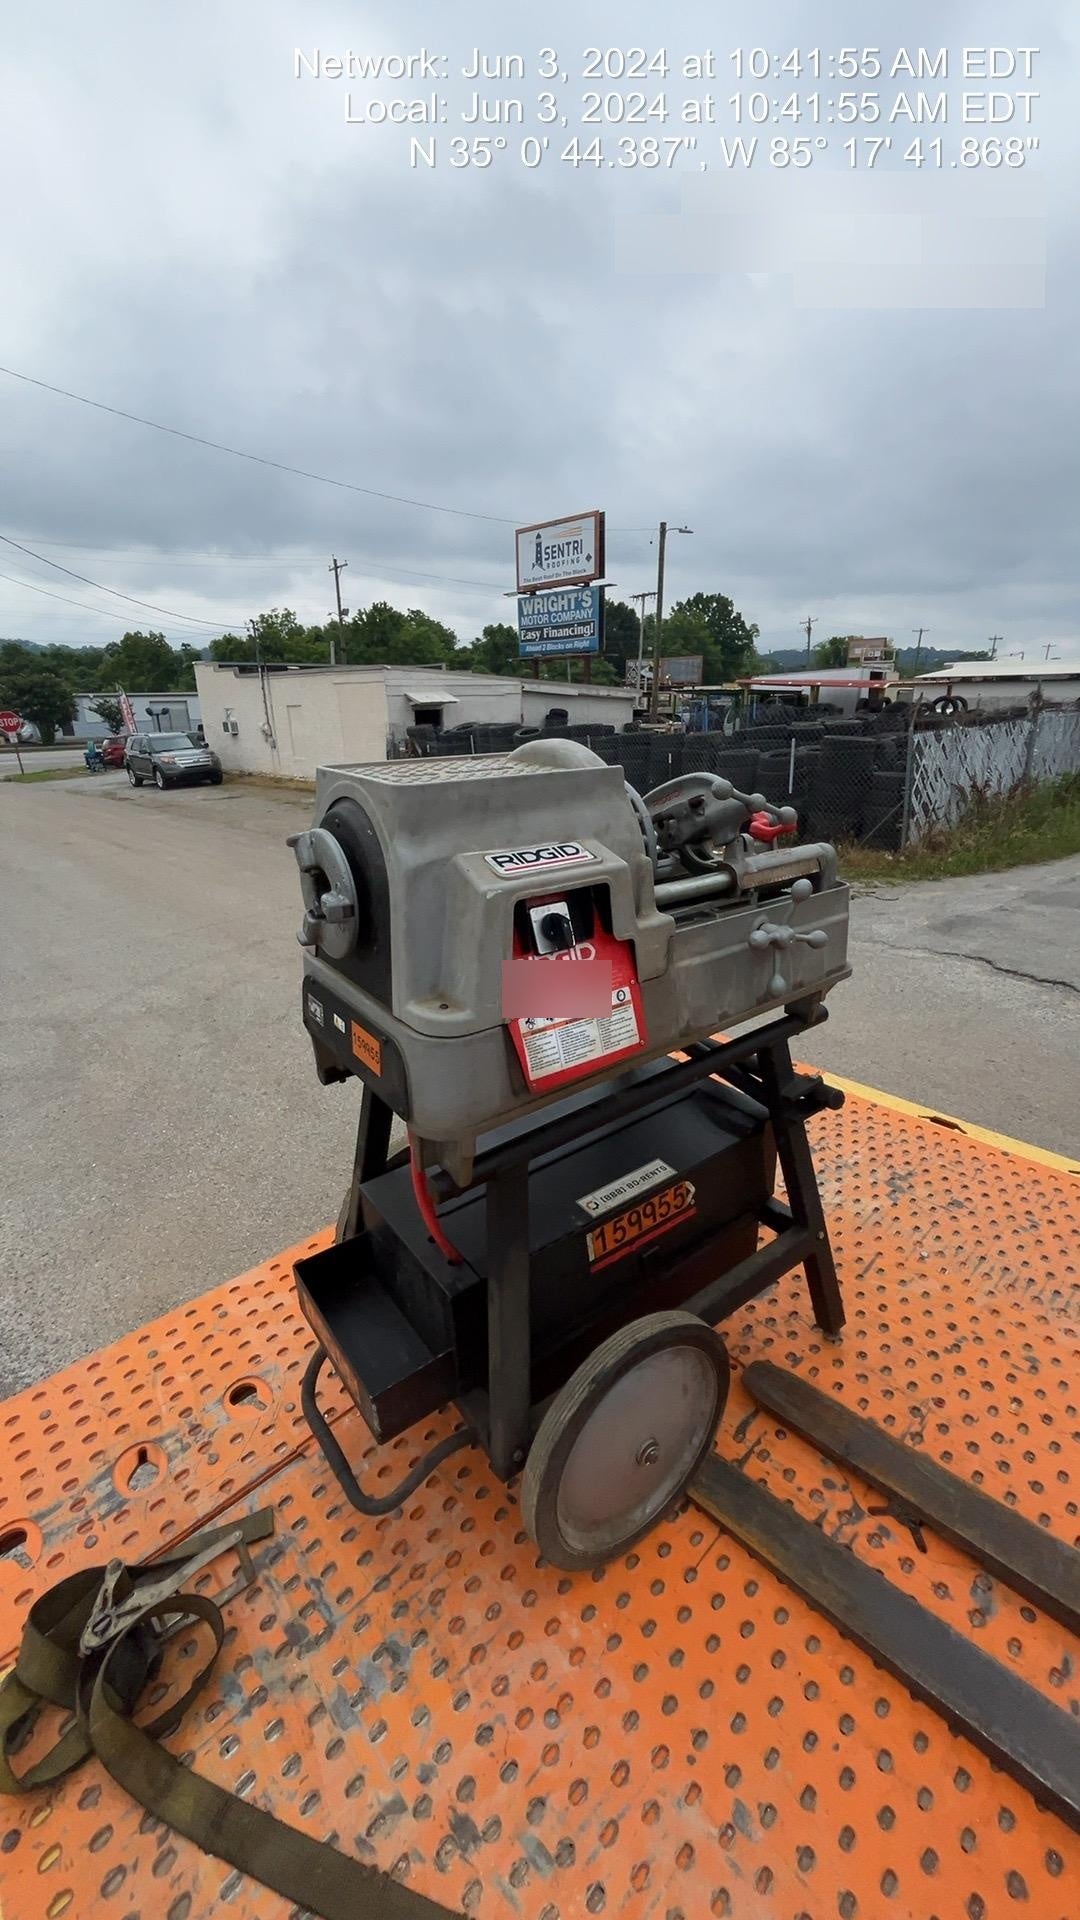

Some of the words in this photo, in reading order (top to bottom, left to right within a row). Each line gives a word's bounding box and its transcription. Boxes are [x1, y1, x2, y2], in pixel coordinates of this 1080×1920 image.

[544, 539, 583, 561] SENTRI
[547, 556, 580, 569] ROOFING
[521, 590, 592, 615] WRIGHT'S
[521, 613, 549, 626] MOTOR
[551, 608, 593, 623] COMPANY
[521, 629, 541, 641] Easy
[543, 622, 594, 637] Financing!
[0, 717, 19, 727] STOP
[491, 844, 581, 868] RIDGID
[595, 1184, 685, 1252] 159955
